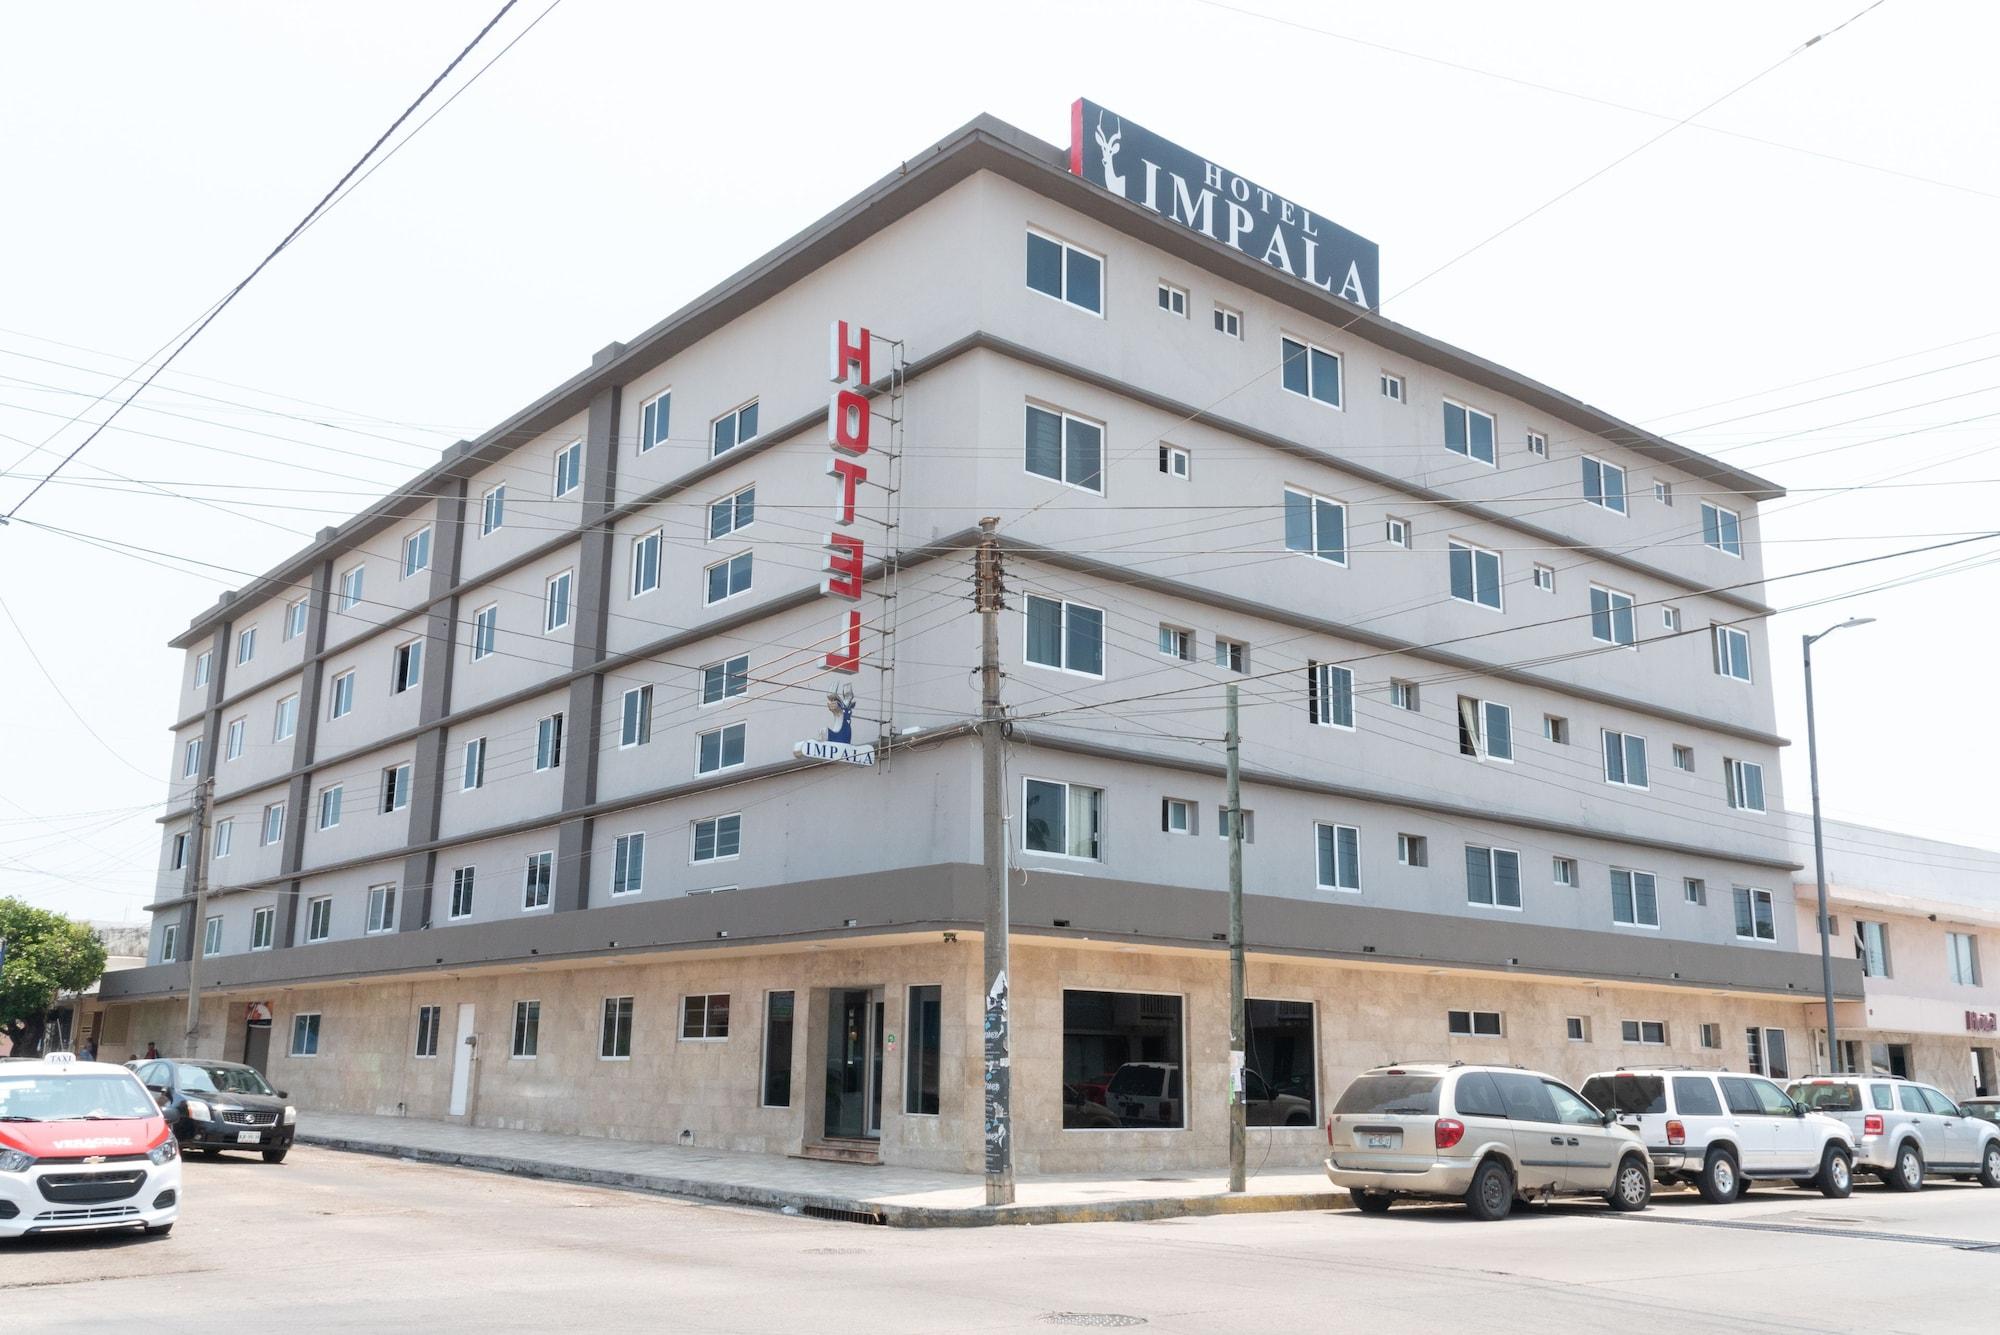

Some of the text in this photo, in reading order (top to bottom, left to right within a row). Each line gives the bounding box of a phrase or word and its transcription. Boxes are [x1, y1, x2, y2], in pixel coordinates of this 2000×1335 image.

[1203, 160, 1319, 238] HOTEL
[1141, 157, 1370, 310] IMPALA
[806, 742, 873, 765] IMPALA
[51, 1055, 72, 1064] TAXI
[53, 1137, 132, 1149] VERACRUZ
